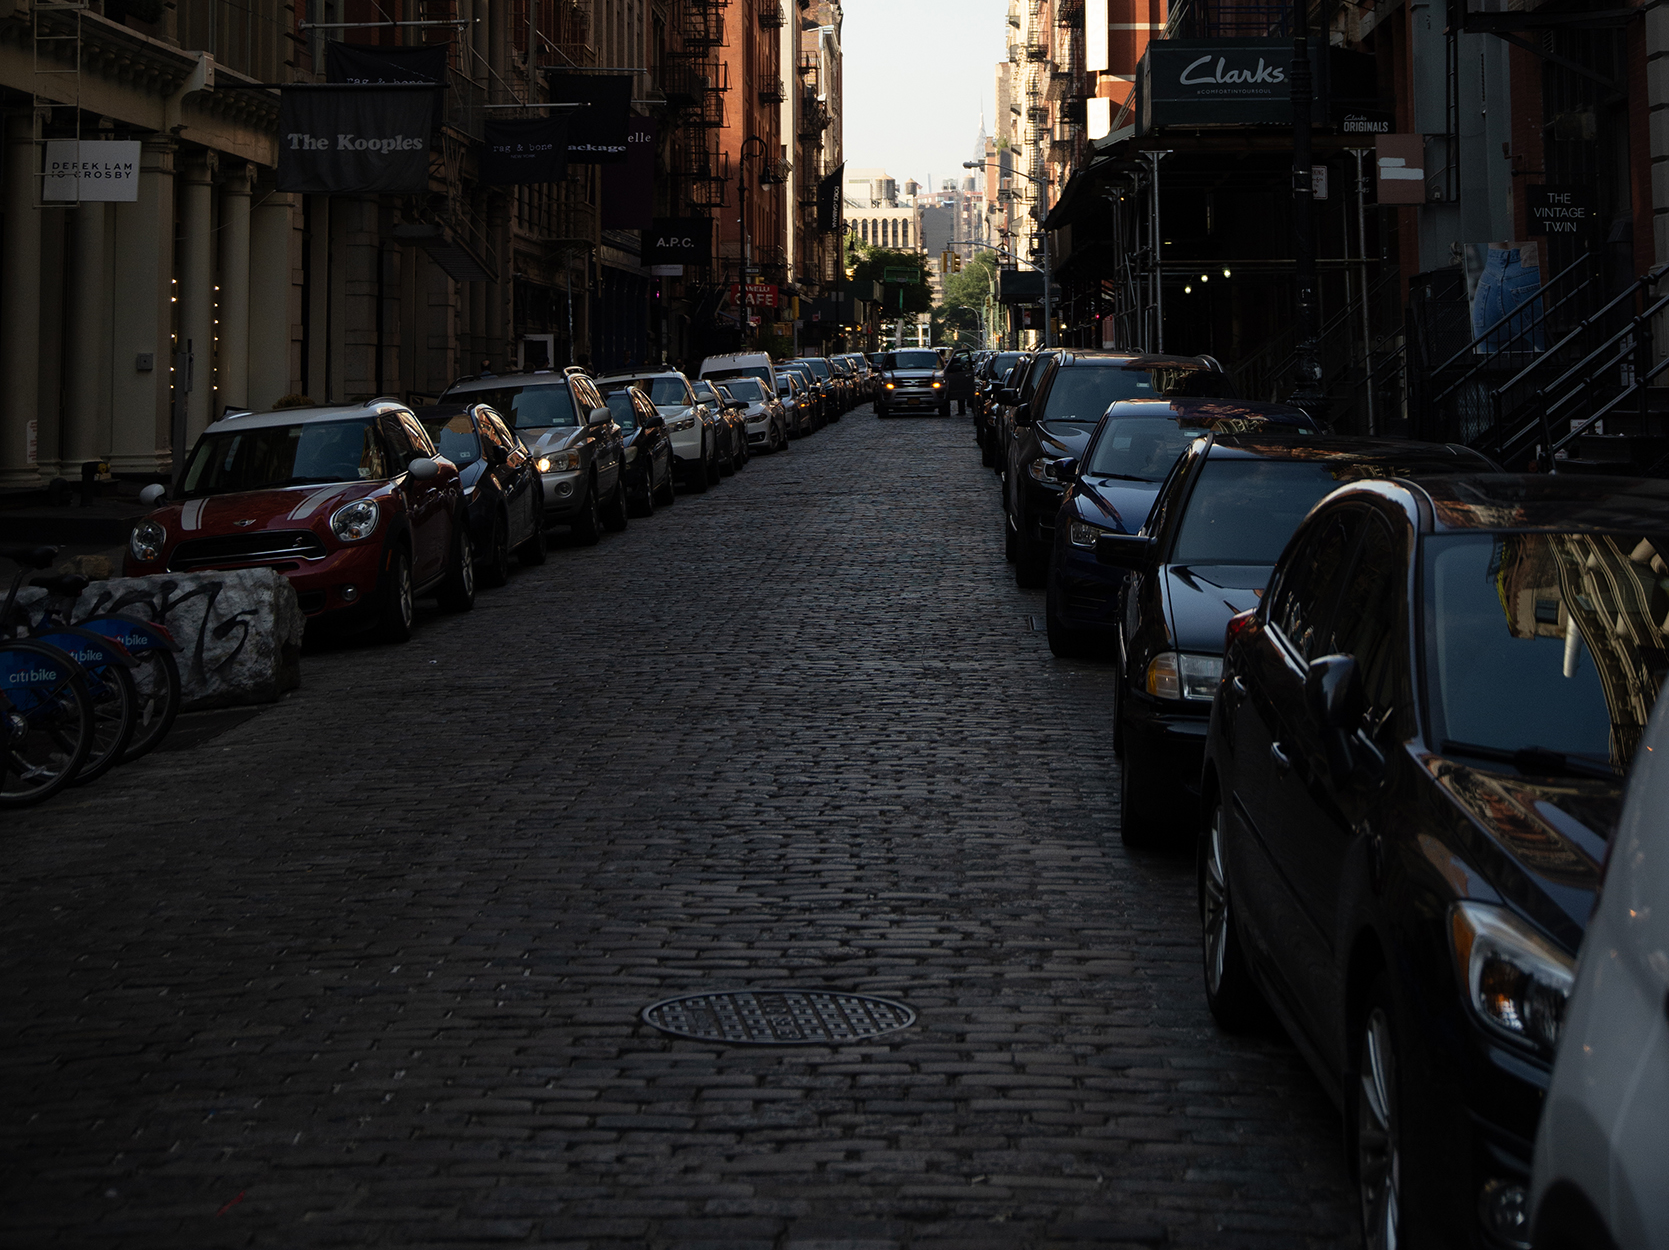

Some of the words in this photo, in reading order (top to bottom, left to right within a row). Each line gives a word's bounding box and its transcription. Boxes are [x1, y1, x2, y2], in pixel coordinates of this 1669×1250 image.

[1179, 55, 1285, 85] Clarks
[1343, 121, 1389, 133] ORIGINALS
[627, 132, 652, 143] elle
[287, 133, 329, 150] The
[336, 134, 423, 154] Kooples
[492, 145, 511, 153] rag
[516, 143, 523, 151] &
[529, 143, 553, 151] bone
[567, 143, 627, 153] ackage
[52, 162, 99, 170] DEREK
[74, 171, 131, 179] CROSBY
[1547, 193, 1571, 204] THE
[1533, 207, 1585, 218] VINTAGE
[1543, 221, 1577, 232] TWIN
[656, 237, 694, 247] A.P.C.
[125, 634, 148, 645] bike
[80, 649, 103, 661] bike
[9, 670, 29, 683] citi
[30, 669, 57, 681] bike
